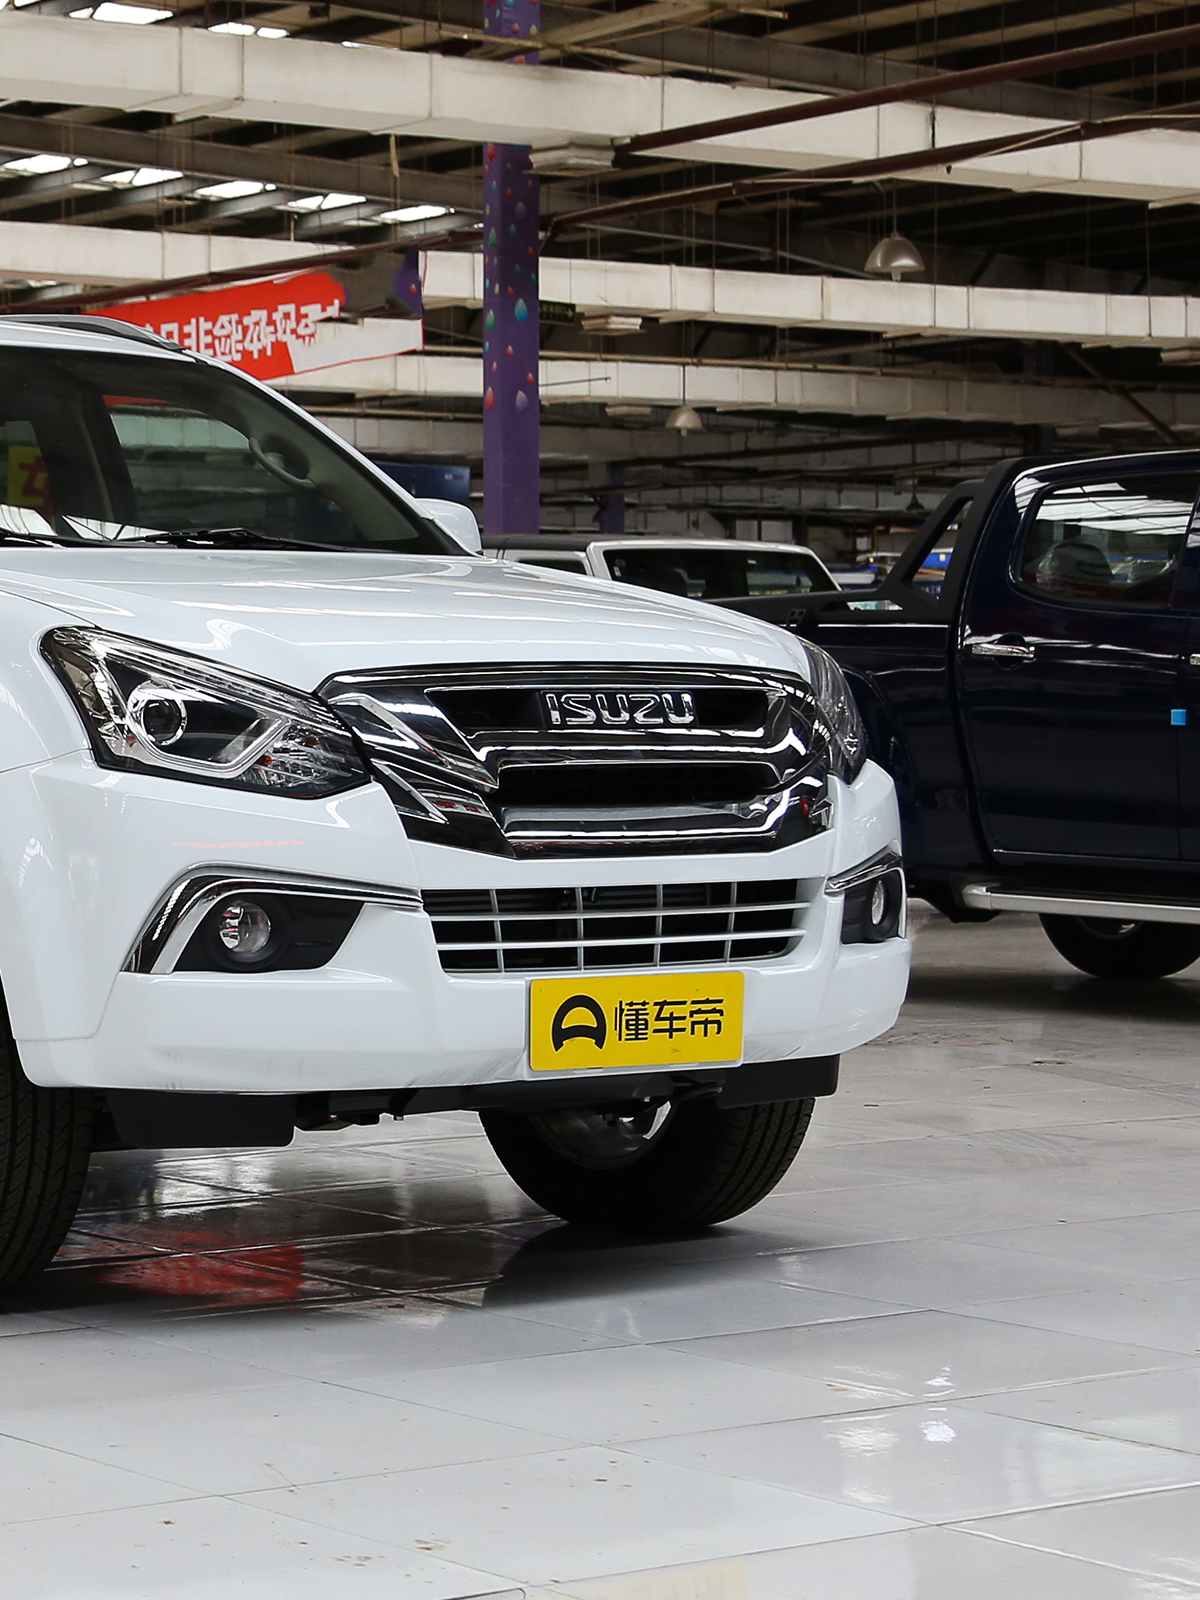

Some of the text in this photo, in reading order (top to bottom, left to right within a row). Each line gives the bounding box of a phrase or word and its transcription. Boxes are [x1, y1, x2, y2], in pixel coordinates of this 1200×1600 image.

[545, 693, 695, 725] ISUZU
[614, 996, 725, 1042] 懂车帝
